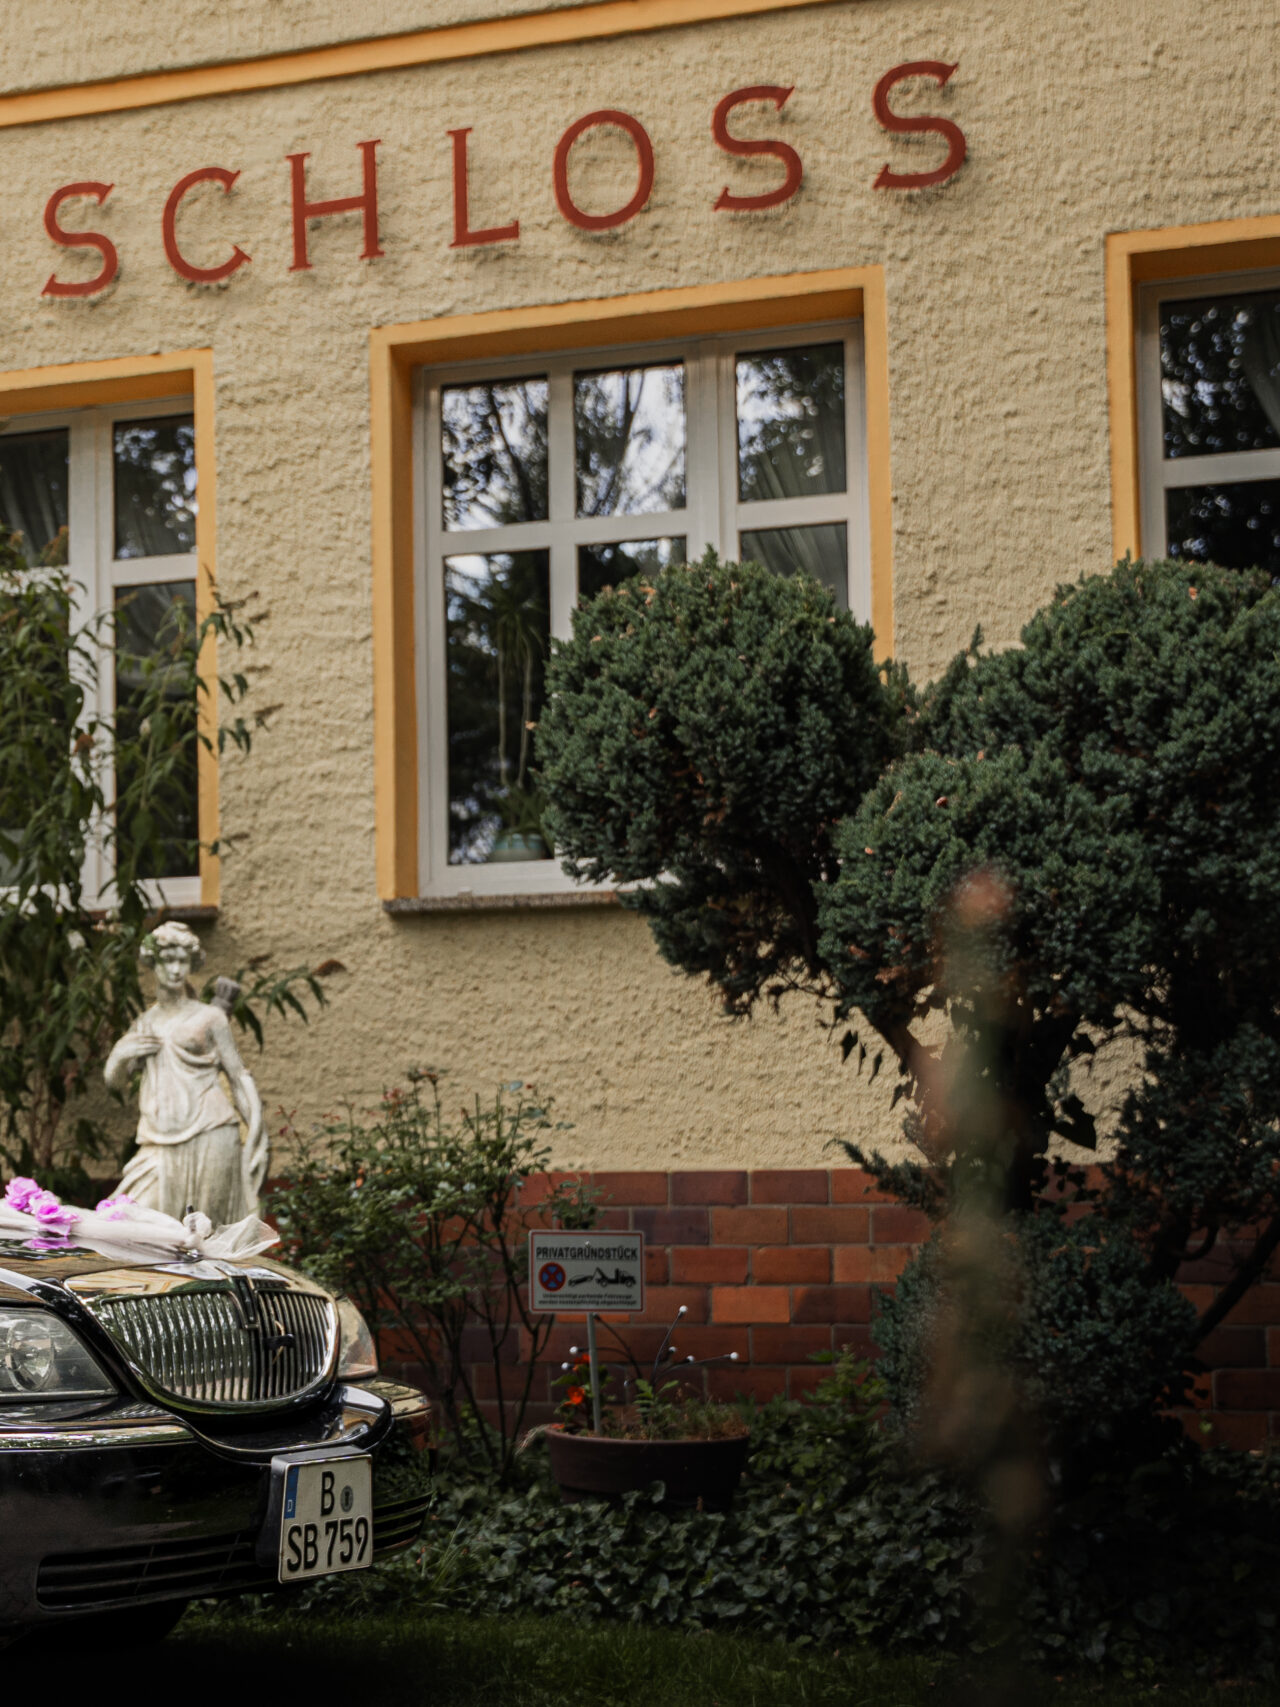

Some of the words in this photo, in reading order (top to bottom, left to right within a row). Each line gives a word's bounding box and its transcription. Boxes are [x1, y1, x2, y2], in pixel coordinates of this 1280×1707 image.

[321, 1471, 335, 1516] B
[287, 1523, 319, 1572] SB
[325, 1516, 369, 1568] 759
